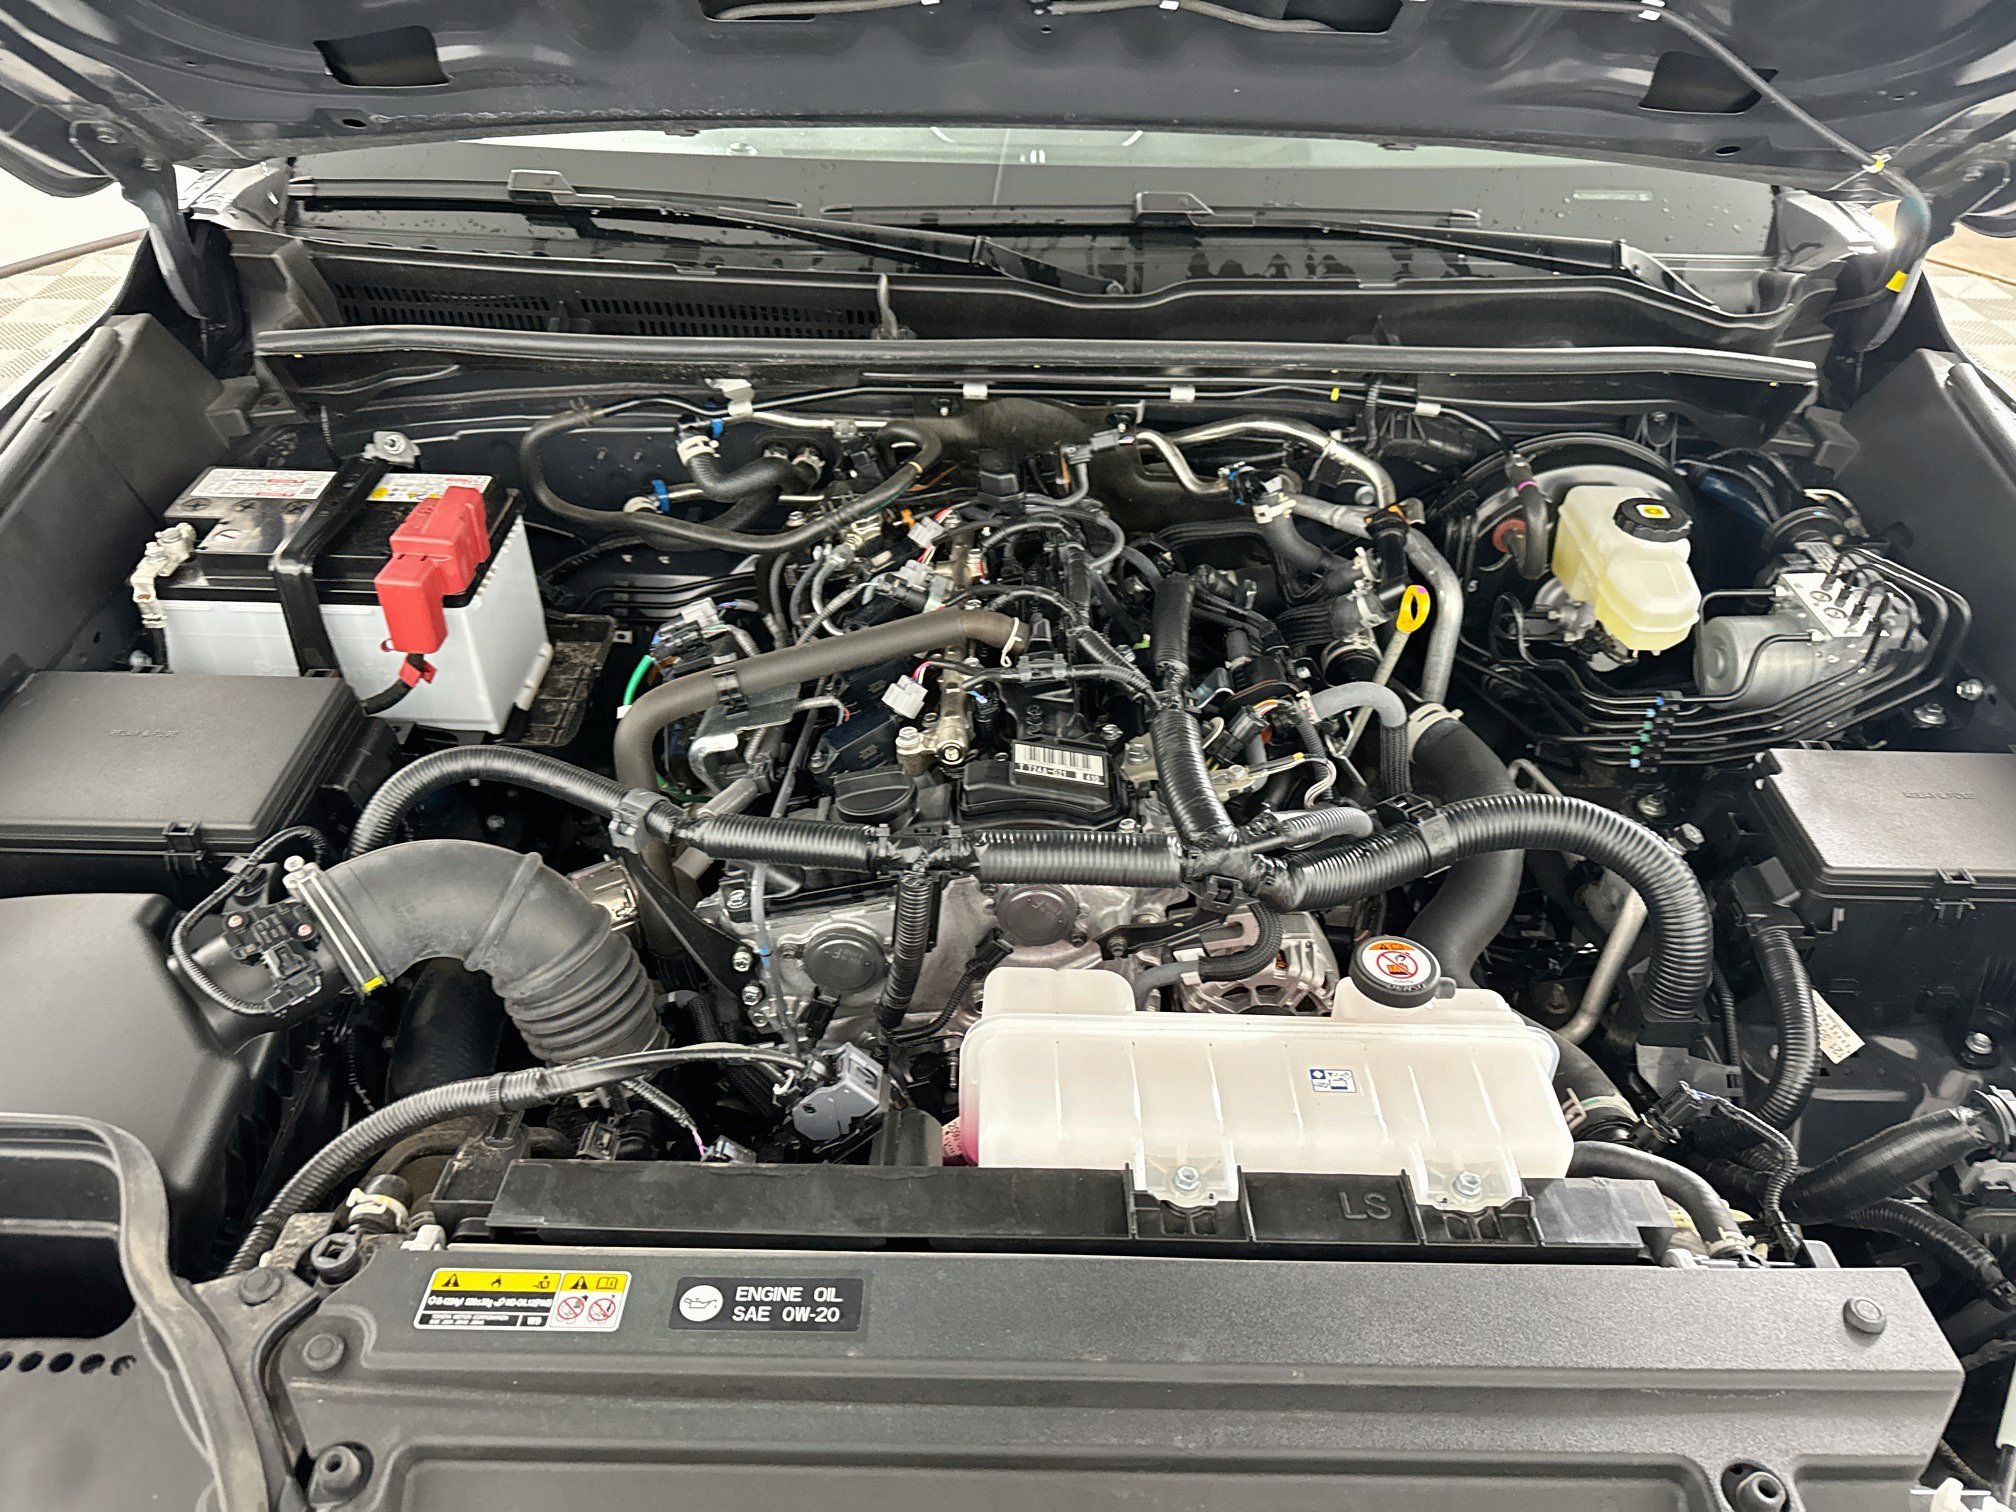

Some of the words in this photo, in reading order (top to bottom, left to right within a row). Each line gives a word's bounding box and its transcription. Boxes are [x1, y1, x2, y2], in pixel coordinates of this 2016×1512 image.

[1339, 1191, 1392, 1219] LS
[735, 1286, 803, 1302] ENGINE
[813, 1287, 843, 1302] OIL
[731, 1305, 772, 1322] SAE
[781, 1306, 840, 1323] 0W-20
